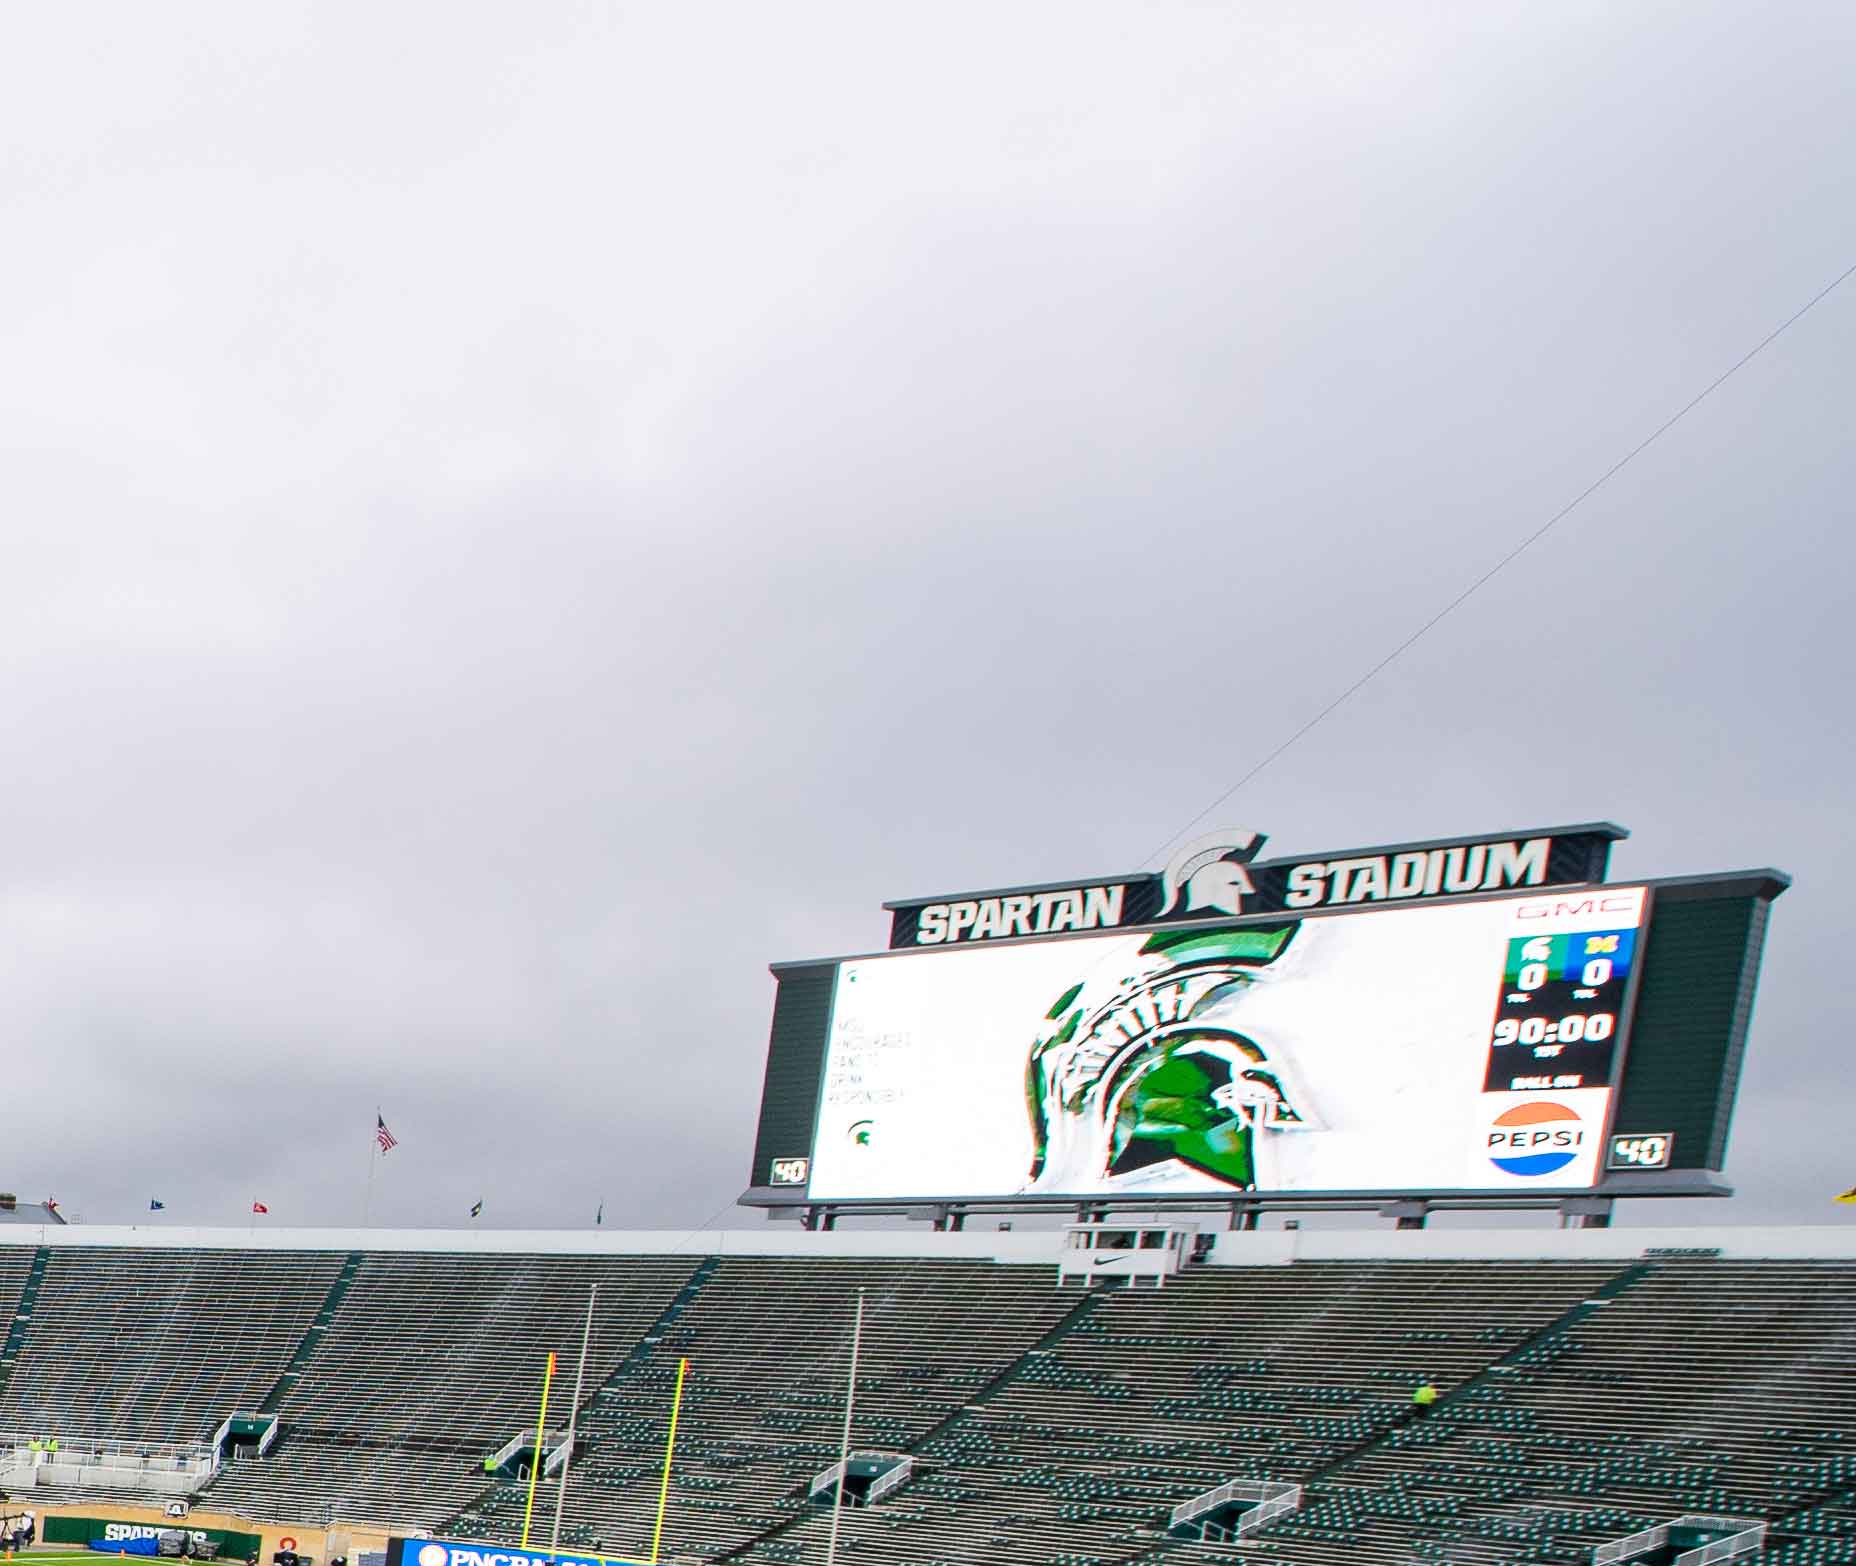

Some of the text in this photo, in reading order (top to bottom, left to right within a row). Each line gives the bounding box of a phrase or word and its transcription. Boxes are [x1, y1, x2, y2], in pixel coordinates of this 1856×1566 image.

[916, 837, 1553, 946] SPARTAN STADIUM
[1516, 896, 1635, 919] GMC
[1517, 963, 1548, 991] 0
[1582, 958, 1614, 987] 0
[1493, 1013, 1615, 1047] 90:00
[1488, 1130, 1584, 1147] PEPSI
[1615, 1137, 1667, 1165] 40
[775, 1160, 807, 1183] 40
